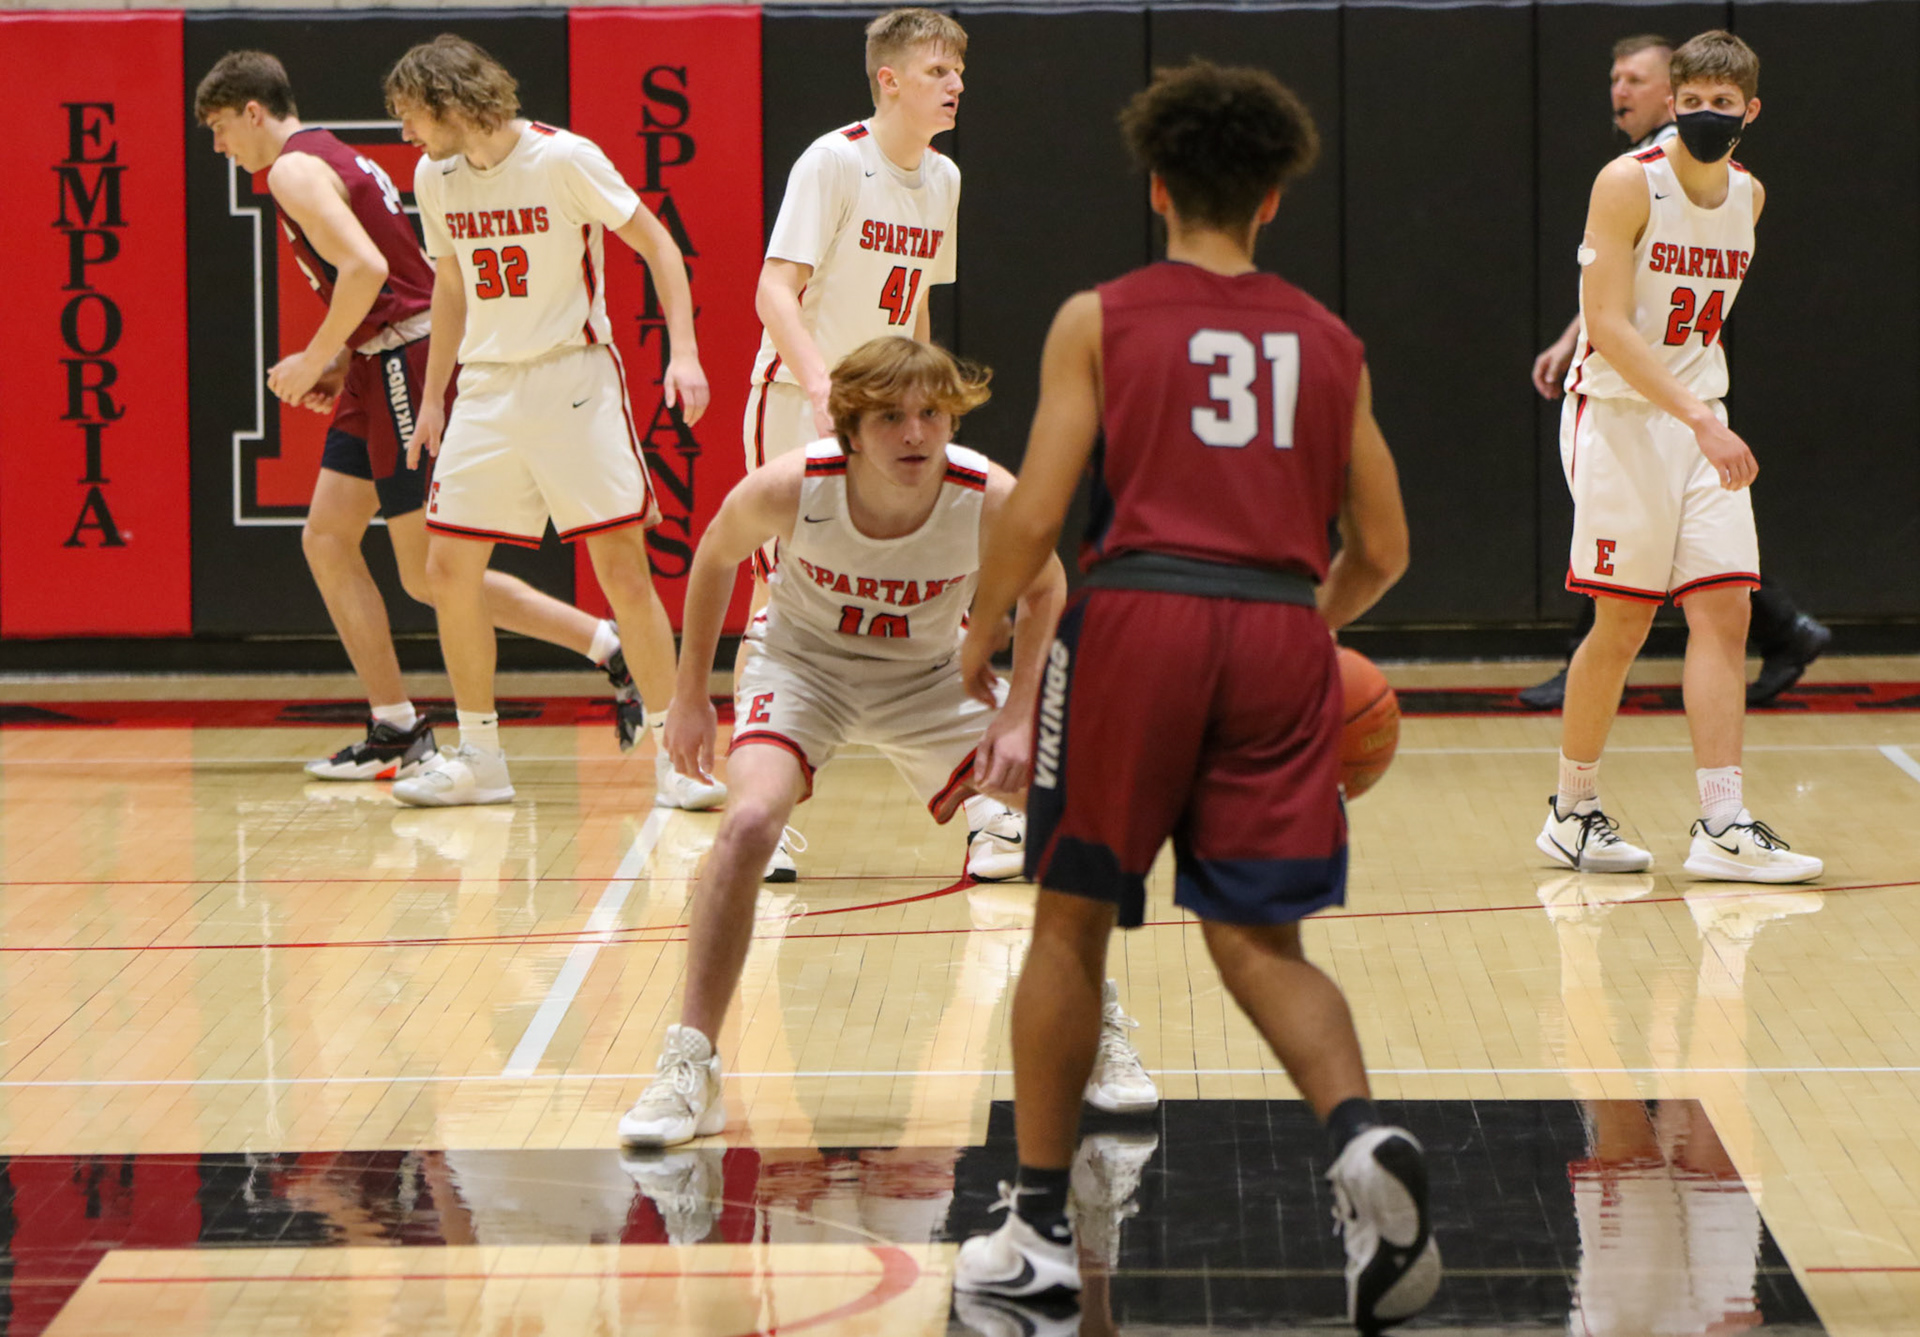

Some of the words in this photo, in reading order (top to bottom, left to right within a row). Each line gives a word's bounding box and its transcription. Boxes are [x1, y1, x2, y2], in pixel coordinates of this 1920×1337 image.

[445, 206, 550, 239] SPARTANS
[472, 245, 529, 300] 32
[1649, 242, 1750, 280] SPARTANS
[50, 102, 128, 545] EMPORIA
[878, 265, 922, 326] 41
[1663, 286, 1724, 347] 24
[1189, 329, 1300, 449] 31
[1592, 539, 1616, 577] E
[746, 692, 774, 726] E
[1034, 638, 1069, 789] VIKINGS
